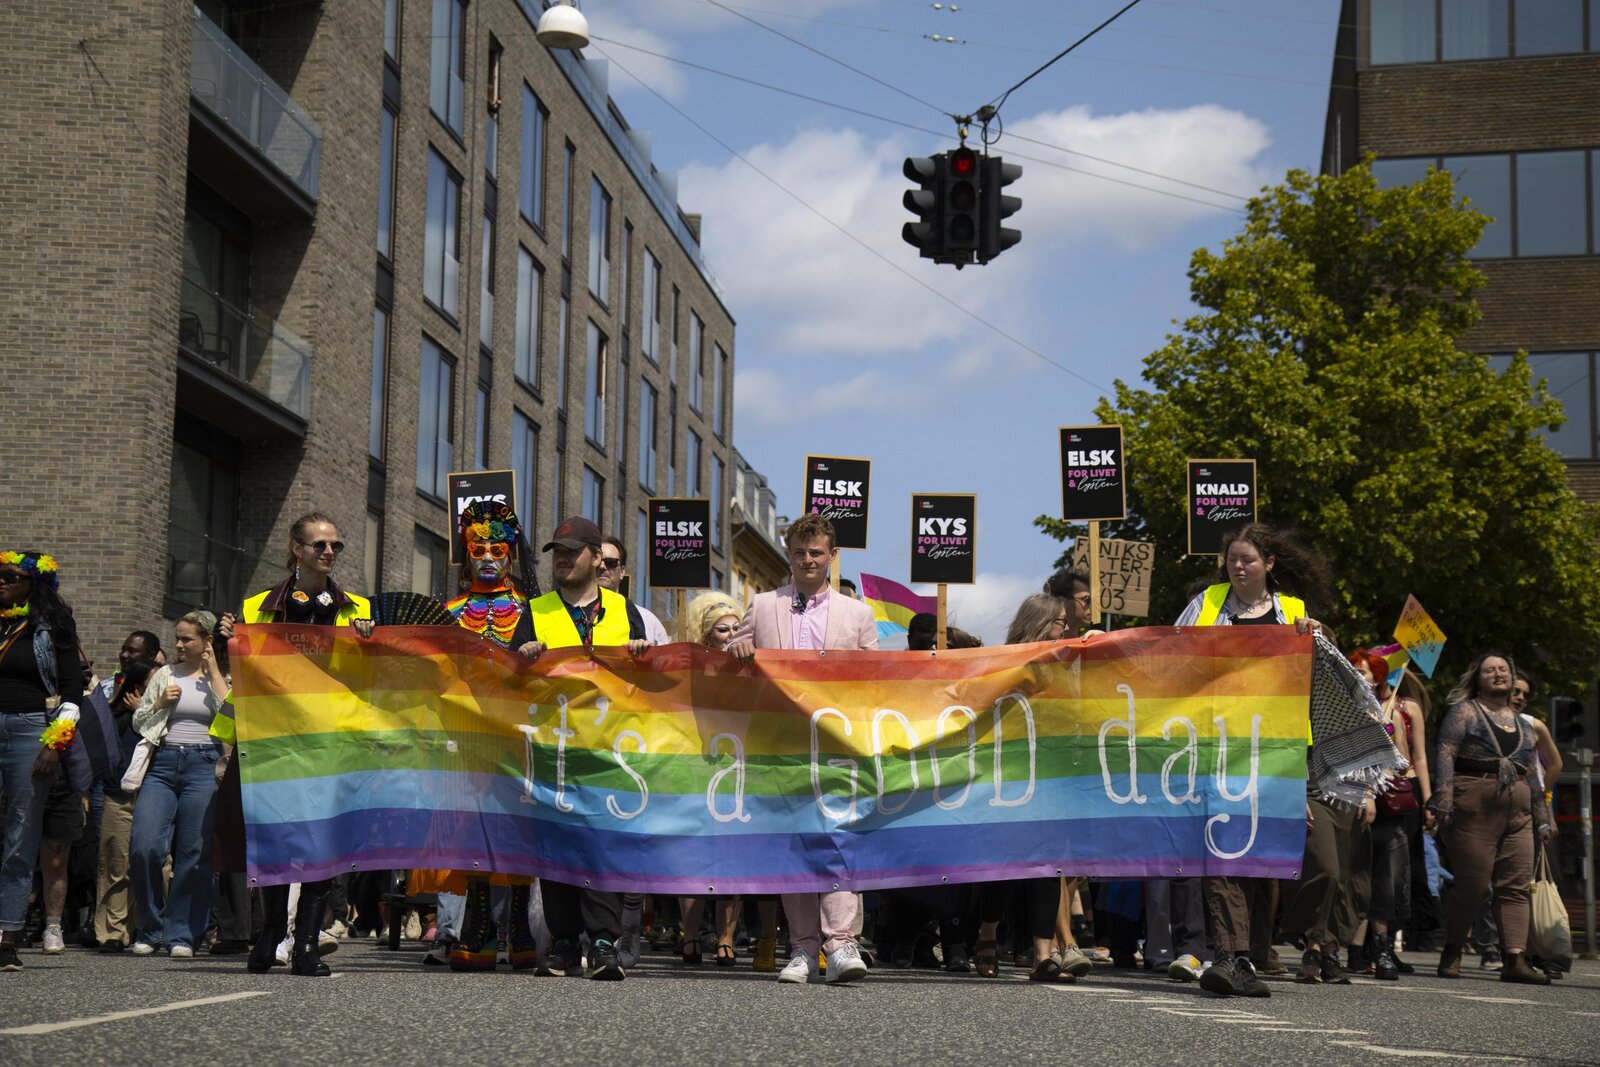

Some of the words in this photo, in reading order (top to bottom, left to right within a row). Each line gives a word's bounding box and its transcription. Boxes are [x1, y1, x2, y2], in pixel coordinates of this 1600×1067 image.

[1068, 449, 1116, 467] ELSK
[1068, 470, 1088, 478] FOR
[1090, 468, 1116, 477] LIVET
[813, 478, 862, 497] ELSK
[1068, 479, 1076, 488] &
[1077, 475, 1119, 493] lysten
[1196, 483, 1250, 496] KNALD
[811, 497, 832, 506] FOR
[834, 498, 862, 508] LIVET
[1196, 497, 1217, 506] FOR
[1220, 497, 1248, 506] LIVET
[811, 506, 819, 515] &
[820, 504, 864, 520] lysten
[1196, 506, 1205, 516] &
[1207, 505, 1252, 522] lysten
[656, 521, 703, 537] ELSK
[919, 517, 967, 536] KYS
[656, 539, 675, 548] FOR
[677, 539, 704, 548] LIVET
[918, 536, 938, 545] FOR
[940, 537, 968, 545] LIVET
[655, 548, 663, 556] &
[664, 545, 706, 561] lysten
[918, 545, 926, 553] &
[927, 543, 971, 560] lysten
[1076, 538, 1150, 561] FNIKS
[1077, 554, 1149, 575] ATER-
[519, 693, 649, 820] it's
[706, 732, 751, 823] a
[810, 706, 1036, 825] GOOD
[1098, 683, 1263, 860] day
